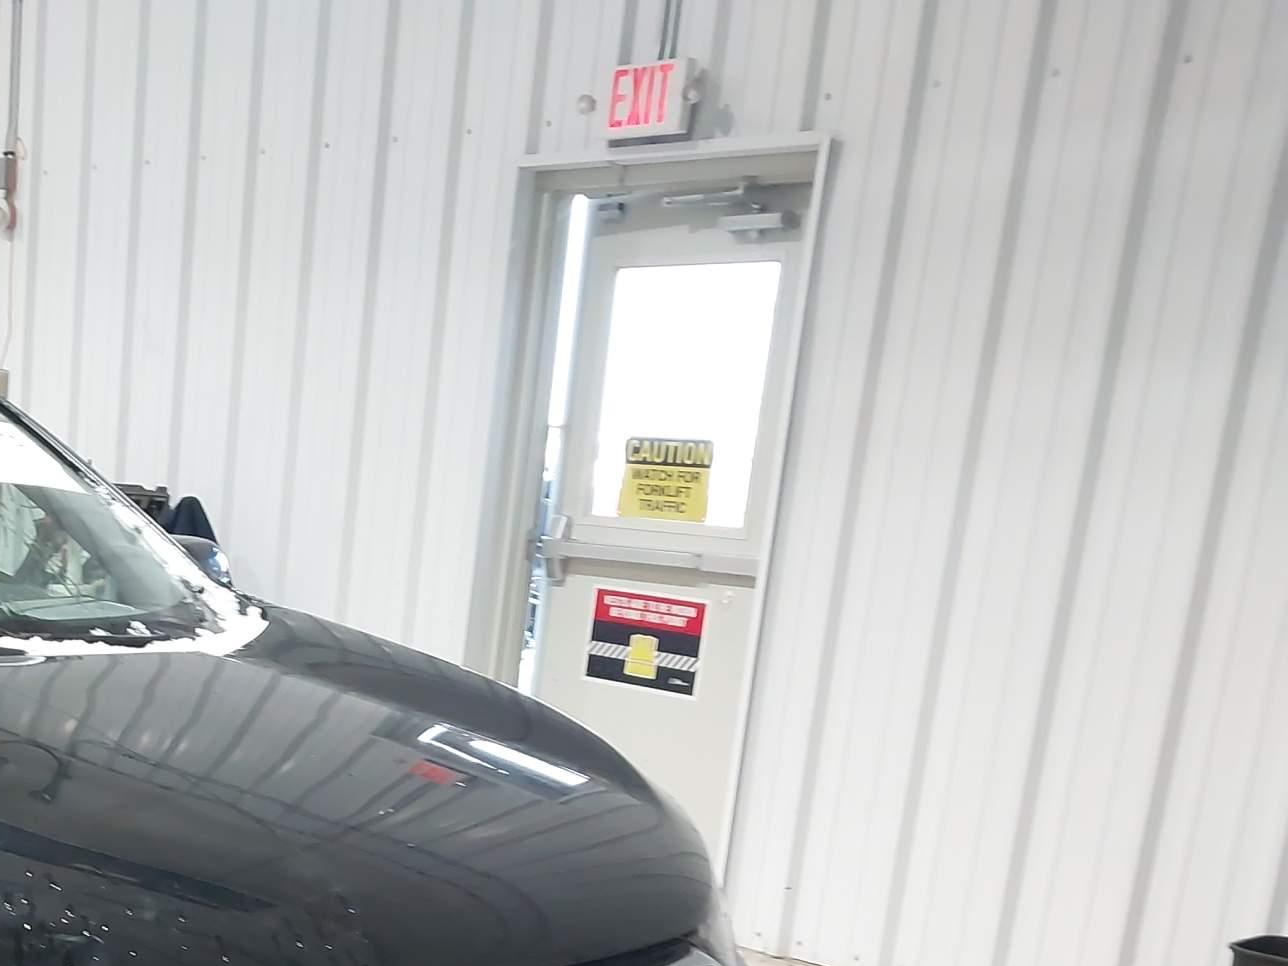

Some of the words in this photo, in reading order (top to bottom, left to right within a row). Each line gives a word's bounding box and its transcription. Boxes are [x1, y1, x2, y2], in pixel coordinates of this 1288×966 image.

[608, 63, 674, 128] EXIT
[626, 440, 713, 466] CAUTION
[631, 467, 674, 482] WATCH
[677, 470, 702, 484] FOR
[636, 483, 693, 499] FORKLIFT
[638, 498, 688, 514] TRAFFIC
